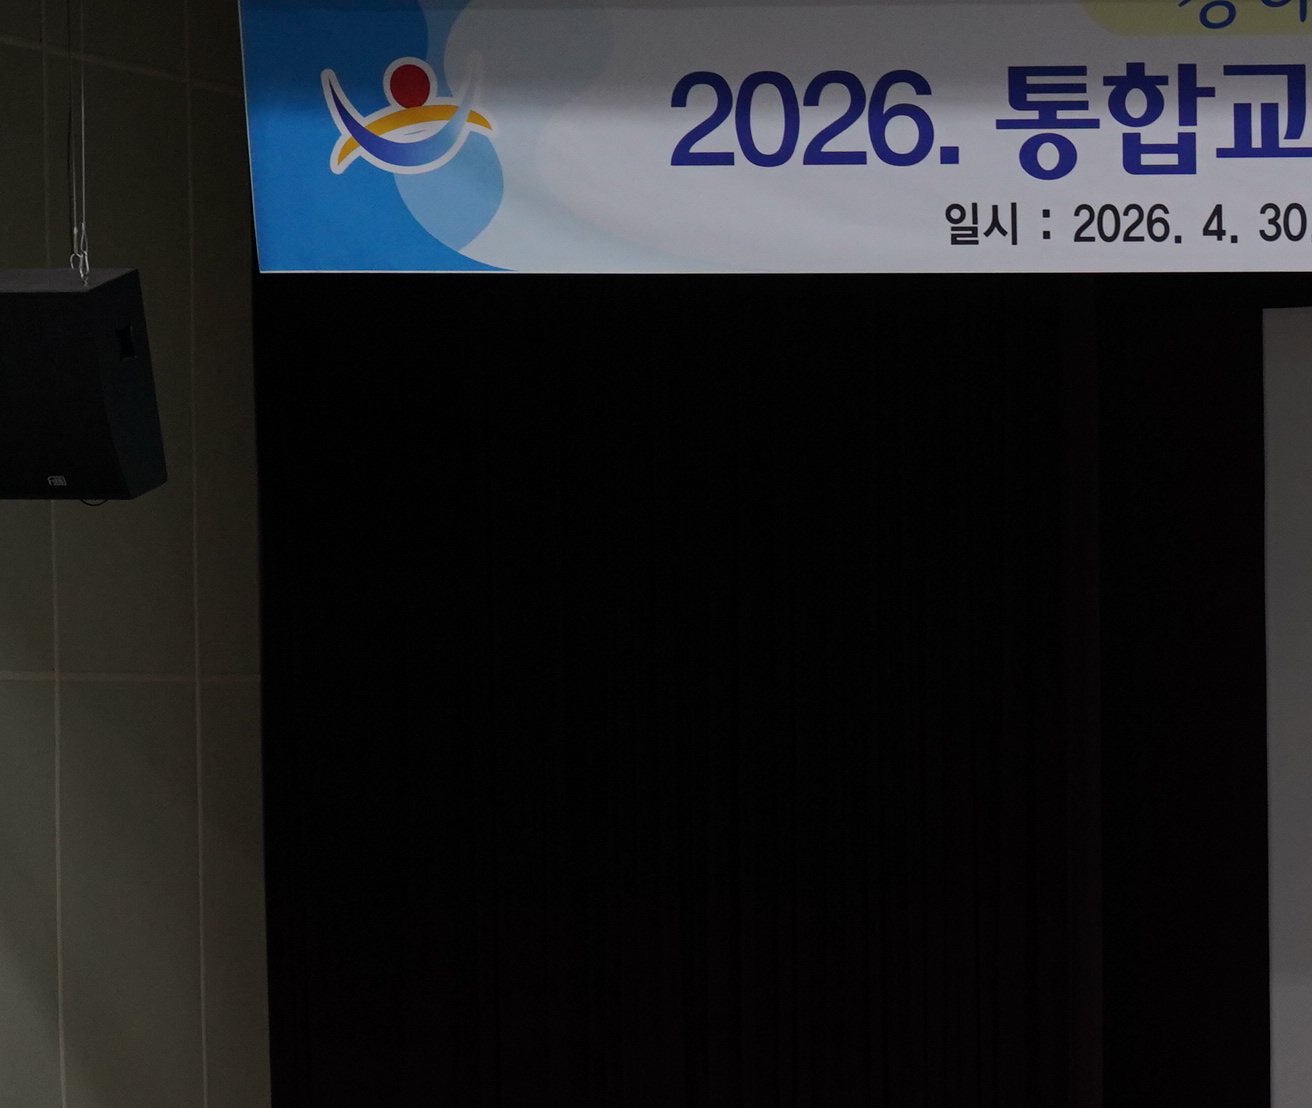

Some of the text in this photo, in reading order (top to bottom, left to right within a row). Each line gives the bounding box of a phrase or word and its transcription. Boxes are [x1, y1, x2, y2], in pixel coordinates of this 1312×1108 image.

[670, 69, 960, 168] 2026.
[944, 201, 1018, 246] 일시
[1041, 208, 1051, 240] :
[1073, 203, 1183, 244] 2026.
[1202, 203, 1239, 244] 4.
